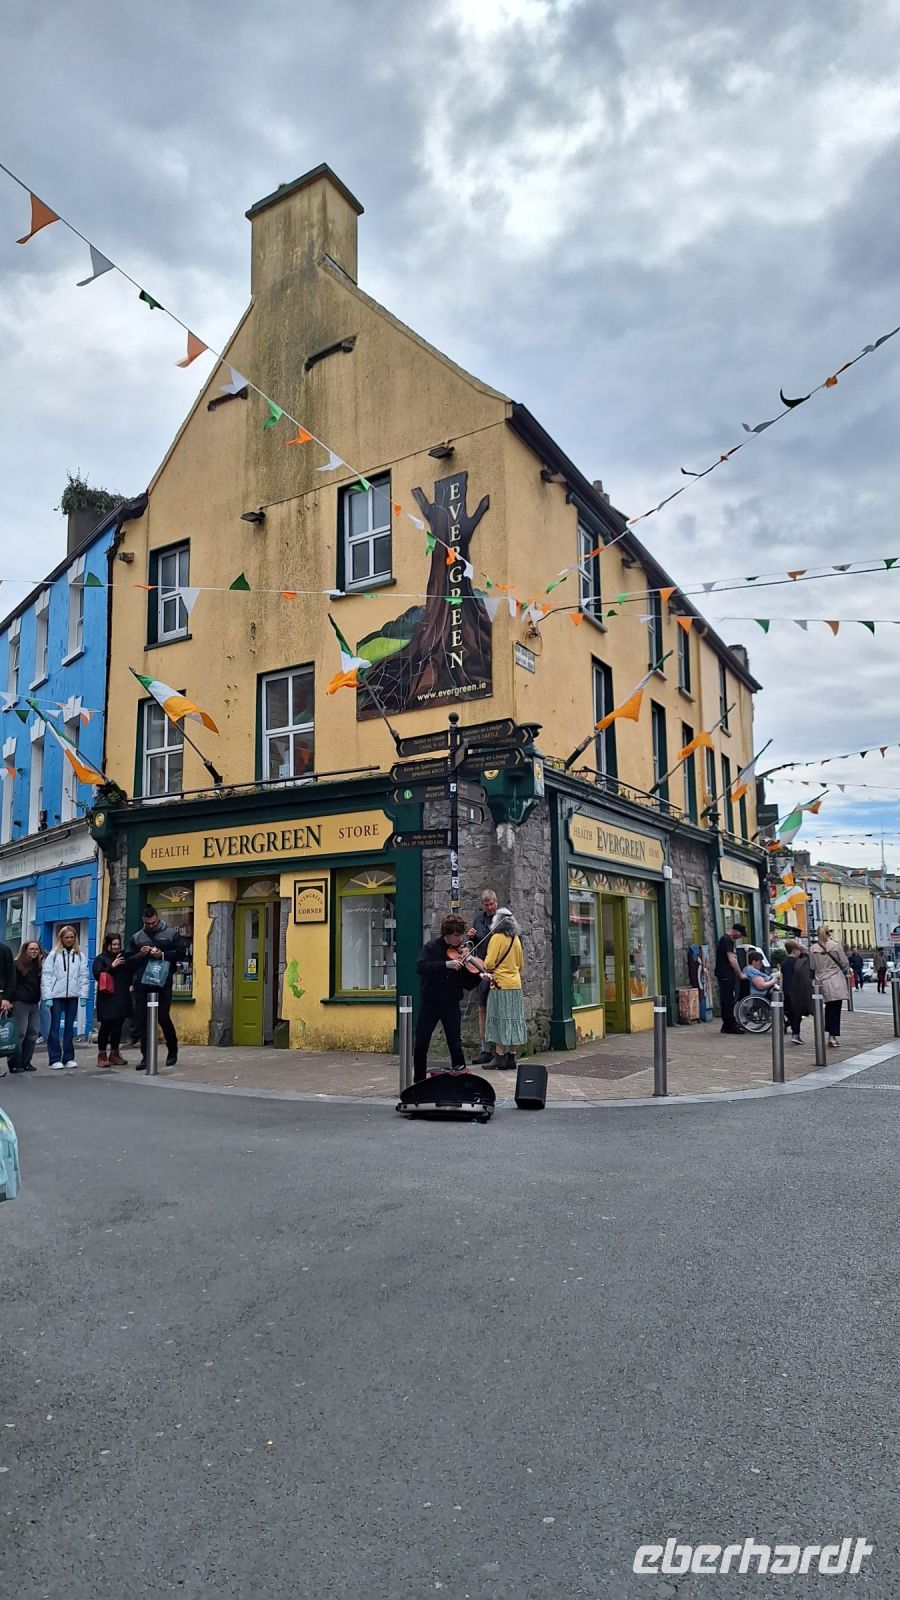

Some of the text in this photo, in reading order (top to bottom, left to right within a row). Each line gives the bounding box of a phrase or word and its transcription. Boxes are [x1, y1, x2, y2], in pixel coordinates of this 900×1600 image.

[416, 681, 487, 701] www.evergreen.ie
[150, 823, 380, 859] HEALTH EVERGREEN STORE
[573, 826, 593, 841] HEALTH
[596, 827, 646, 862] EVERGREEN
[298, 907, 322, 915] CORNER
